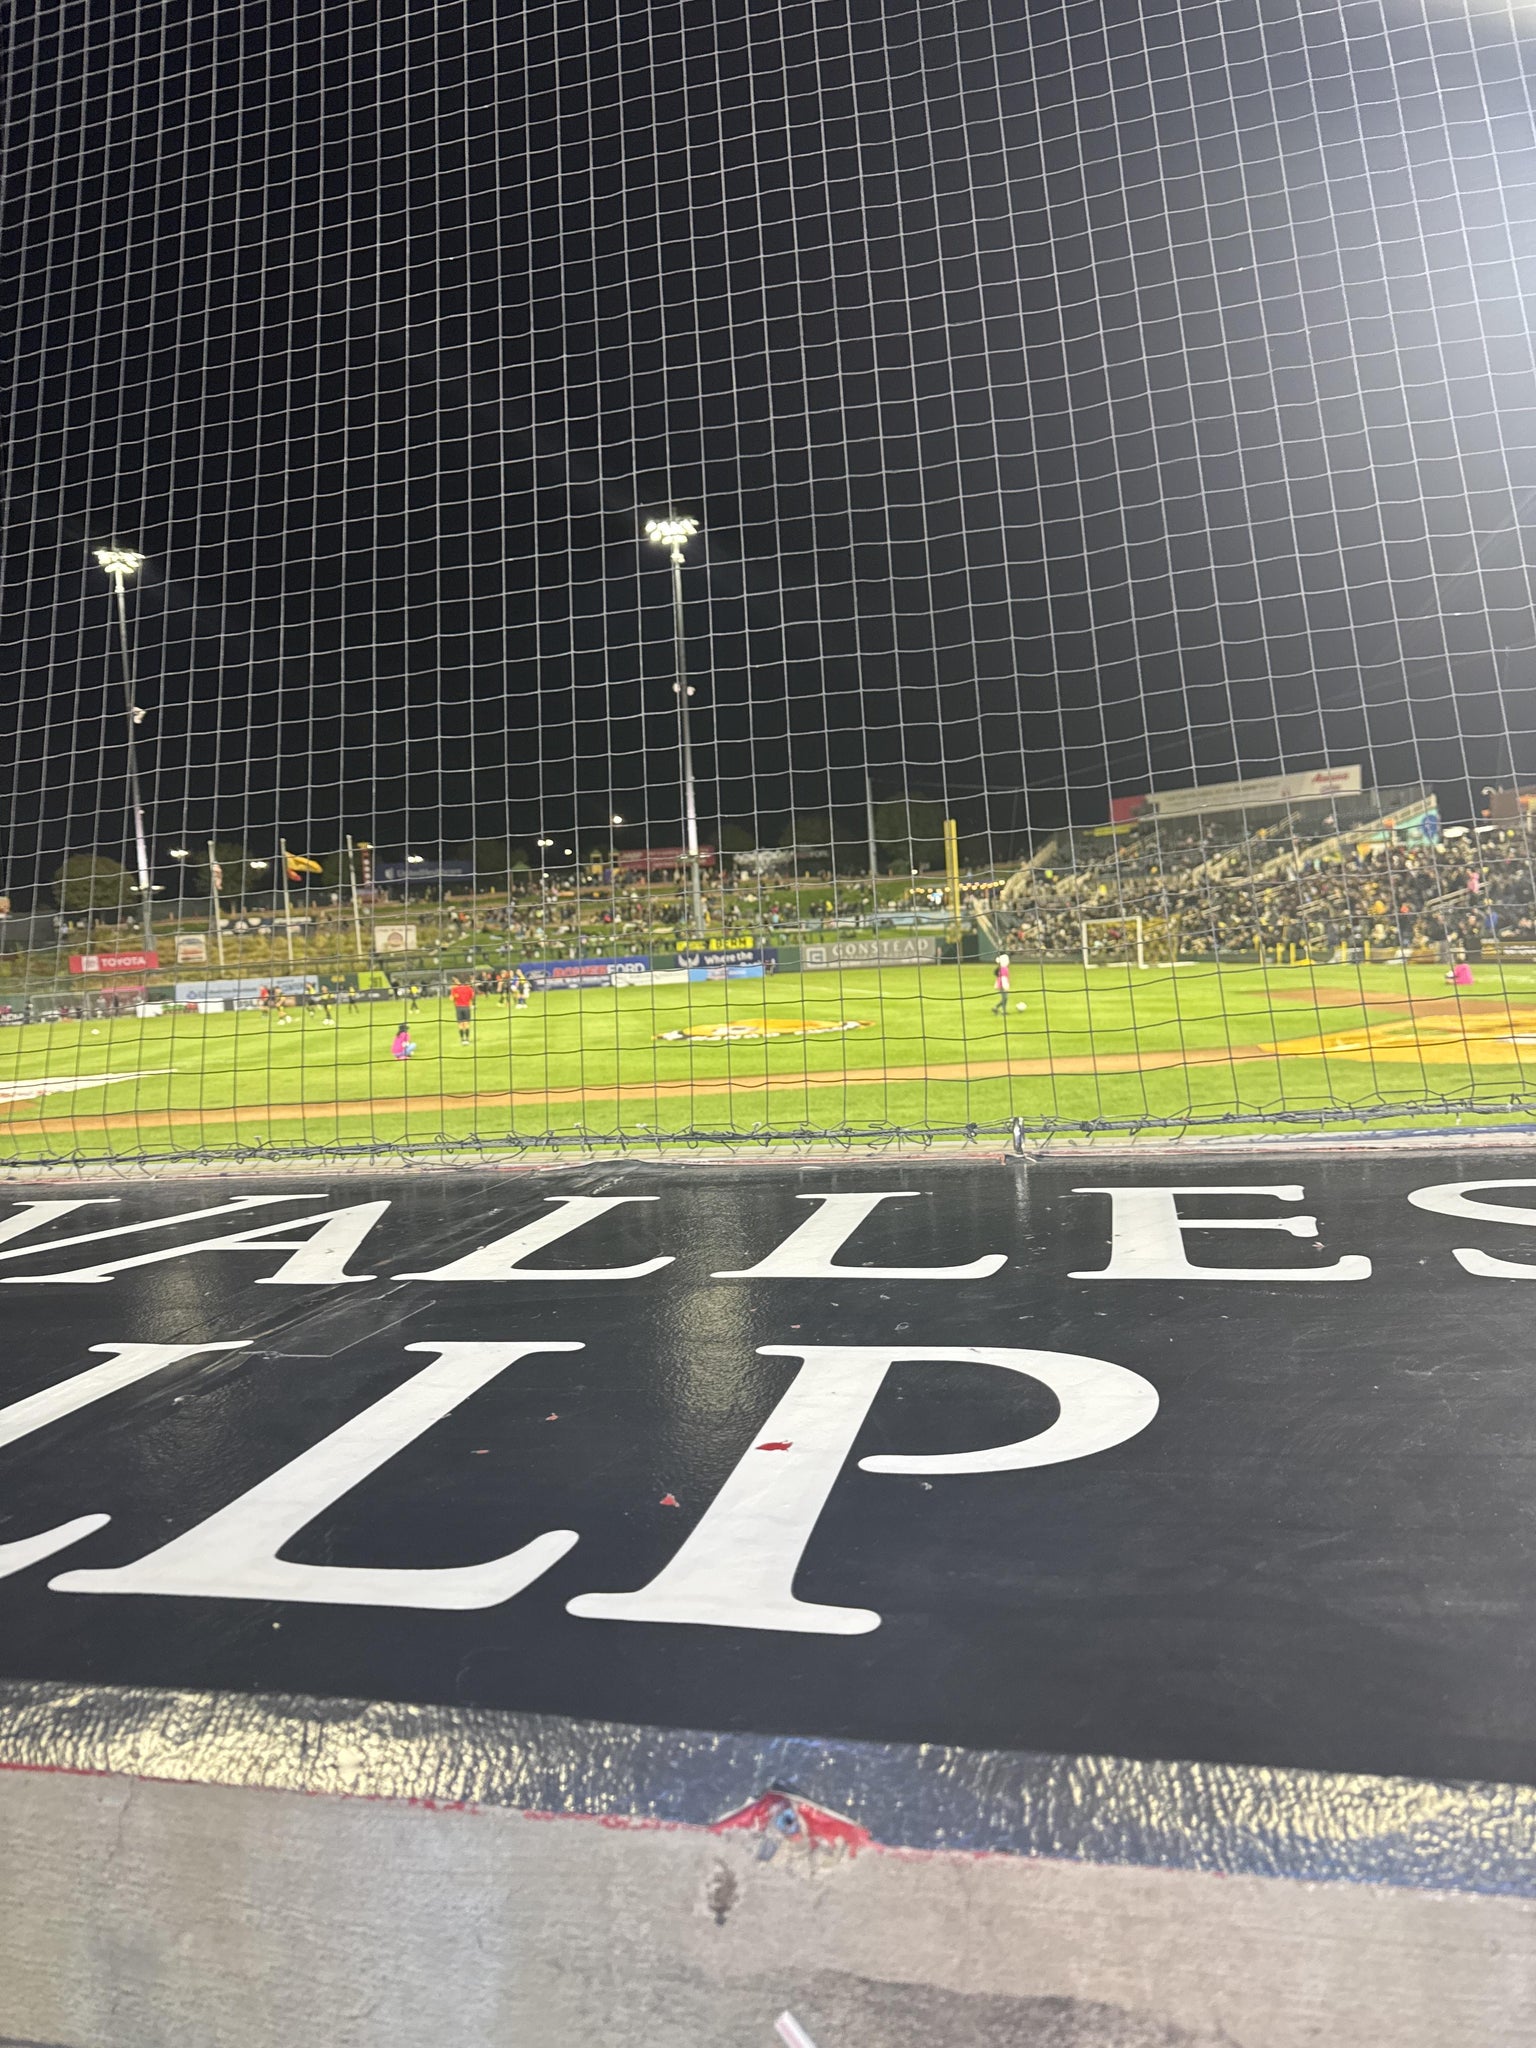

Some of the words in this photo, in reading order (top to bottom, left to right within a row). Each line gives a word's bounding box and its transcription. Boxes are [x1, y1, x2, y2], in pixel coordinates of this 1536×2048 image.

[832, 938, 929, 957] GONSTEAD
[736, 950, 754, 961] the
[101, 956, 147, 968] TOYOTA
[606, 962, 646, 975] FORD
